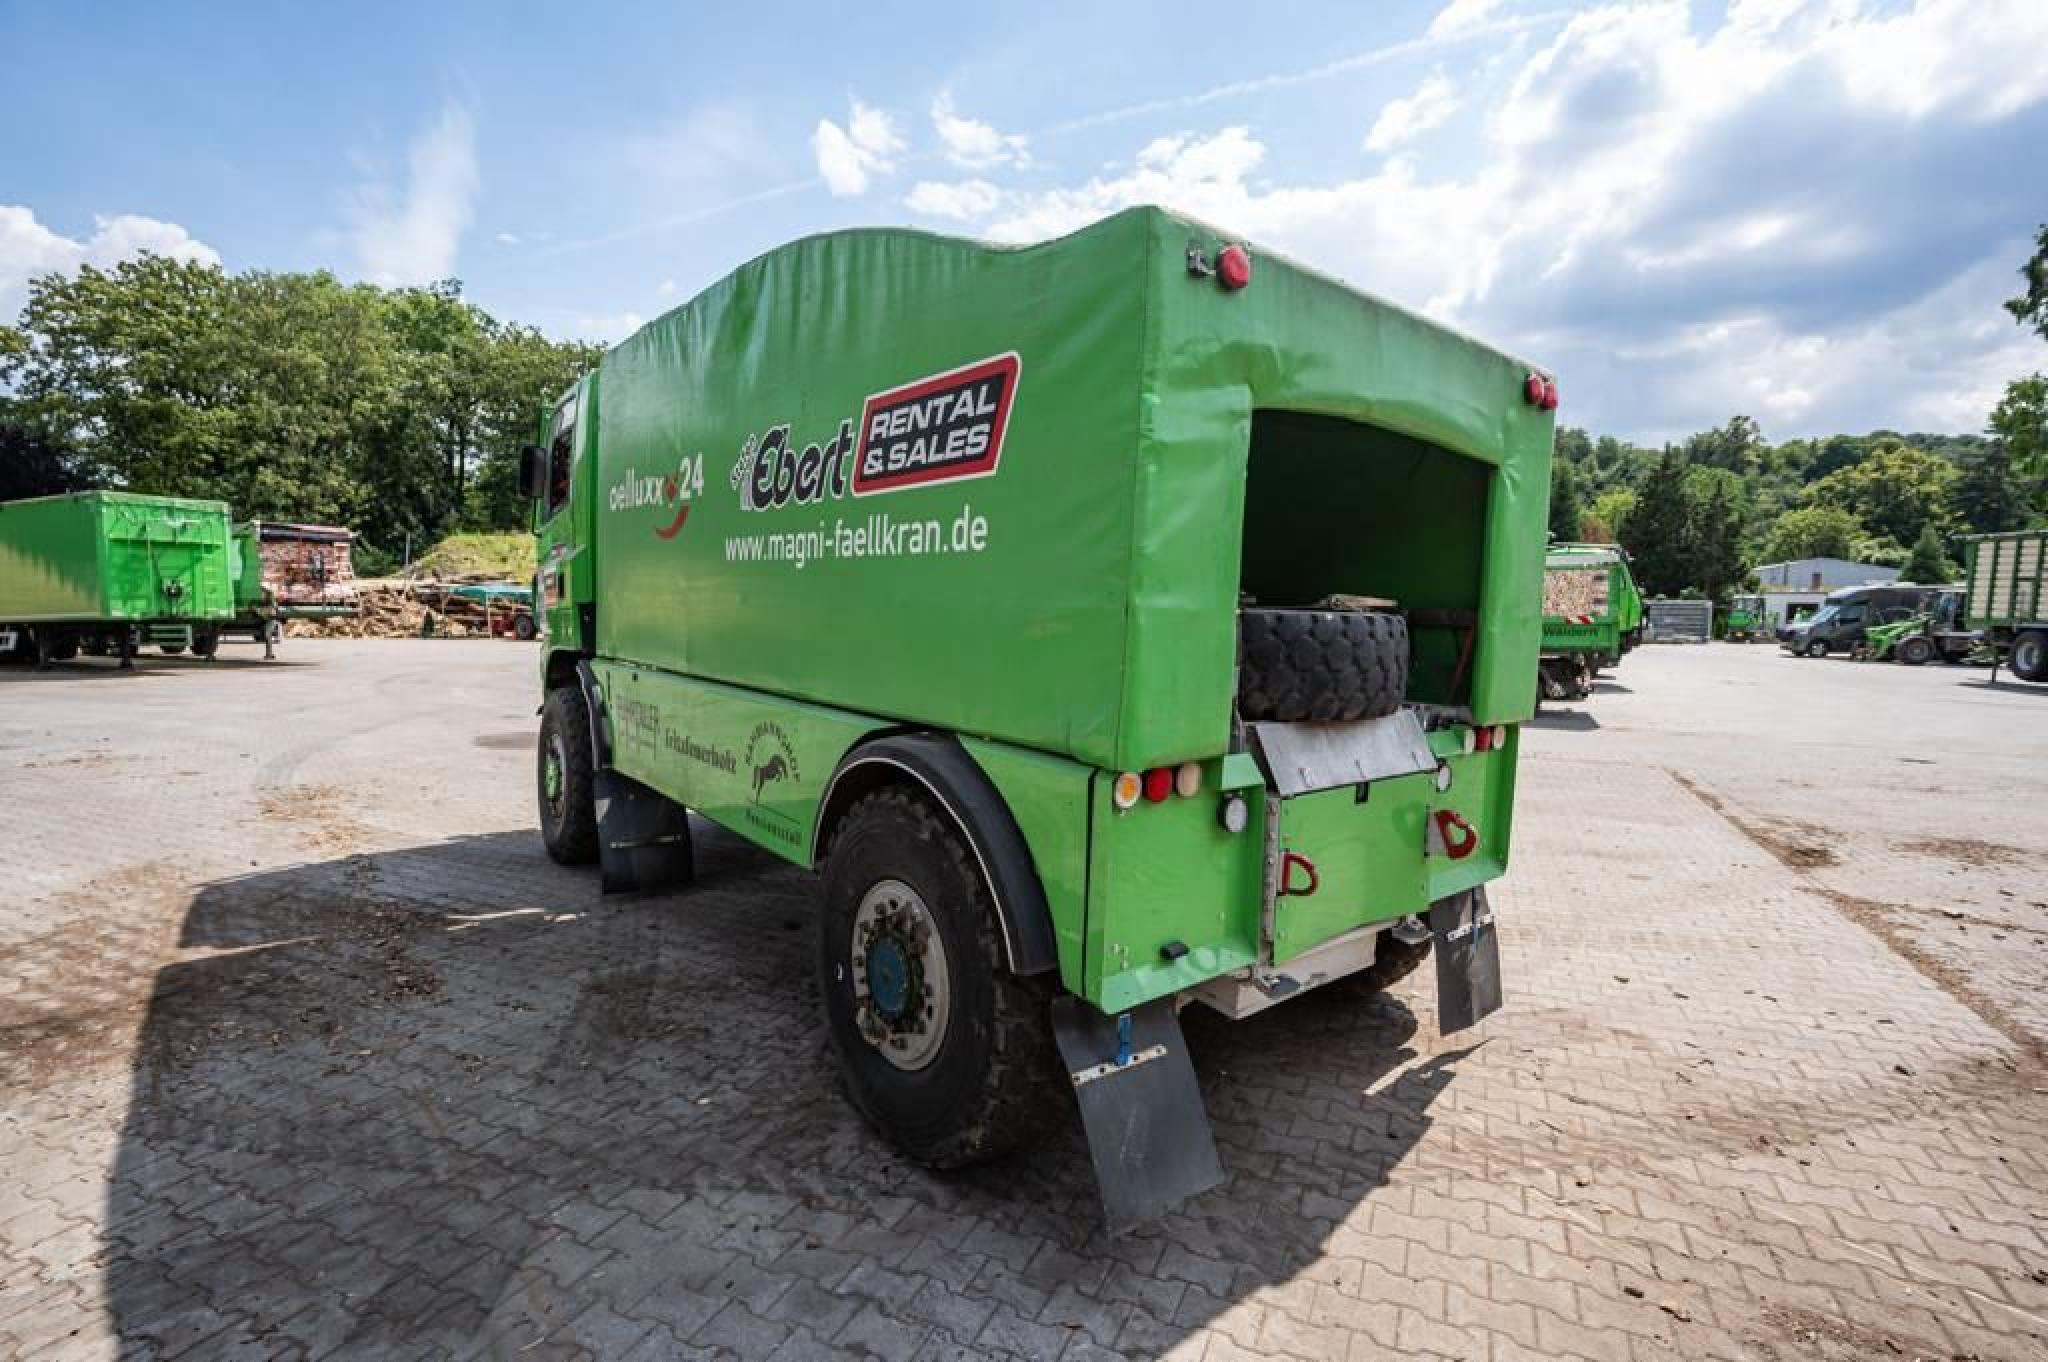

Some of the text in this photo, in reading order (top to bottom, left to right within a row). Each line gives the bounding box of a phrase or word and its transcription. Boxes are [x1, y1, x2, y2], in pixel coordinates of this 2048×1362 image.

[869, 384, 996, 441] RENTAL
[679, 451, 705, 499] 24
[751, 417, 855, 512] Ebert
[863, 423, 991, 475] & SALES
[725, 503, 989, 569] www.magni-faellkran.de
